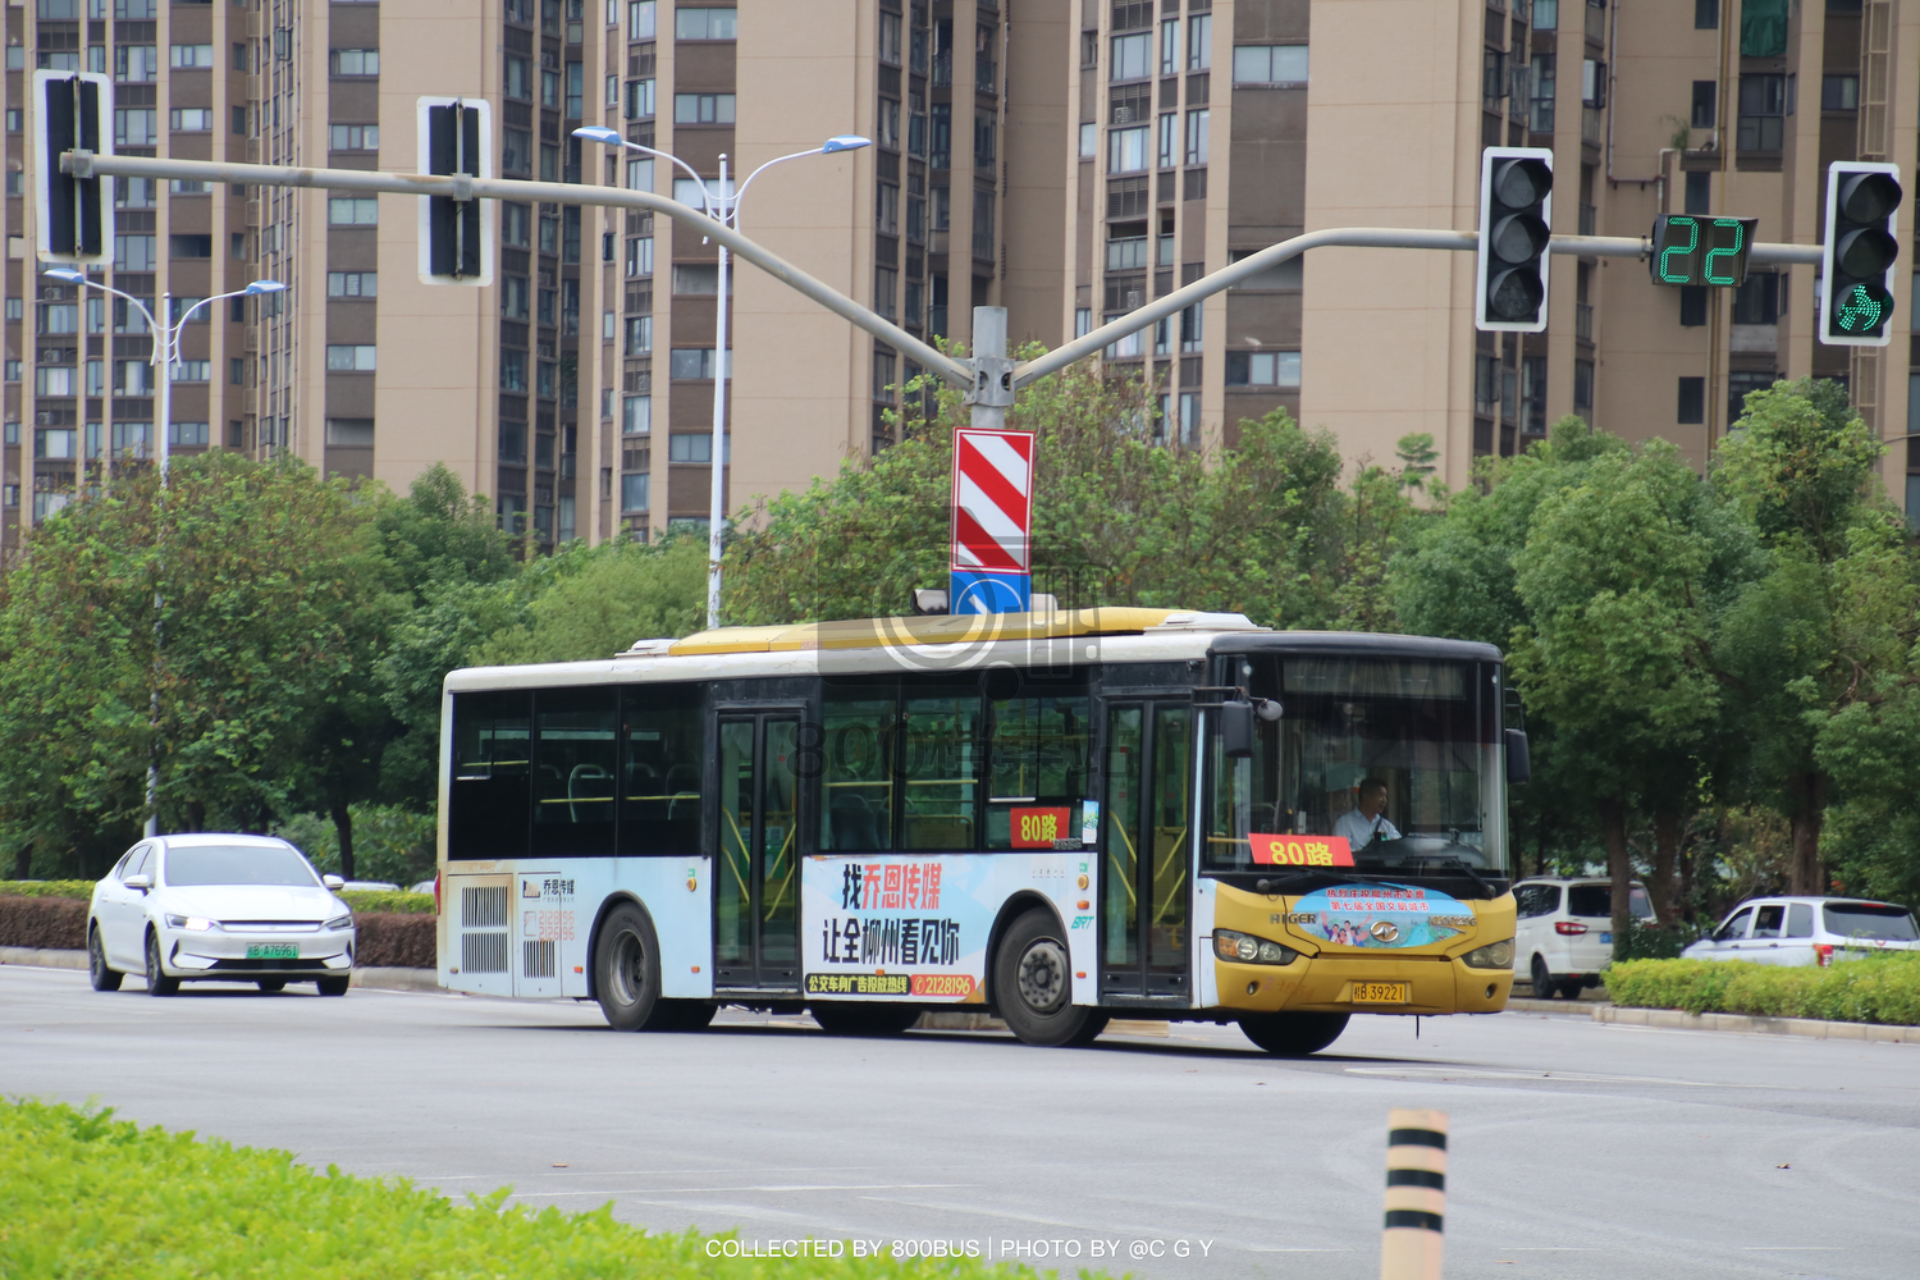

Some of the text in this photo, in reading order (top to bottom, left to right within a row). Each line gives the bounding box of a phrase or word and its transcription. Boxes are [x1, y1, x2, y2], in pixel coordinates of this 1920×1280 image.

[1660, 217, 1744, 285] 22
[1020, 813, 1058, 843] 80路
[1269, 841, 1333, 867] 80路
[543, 879, 575, 896] 乔恩传媒
[842, 863, 942, 910] 找乔恩传媒
[1071, 916, 1095, 929] BRT
[1270, 913, 1317, 925] HIGER
[823, 918, 960, 965] 让全柳州看见你
[808, 975, 971, 995] 公交车身广告投放热线 2128196
